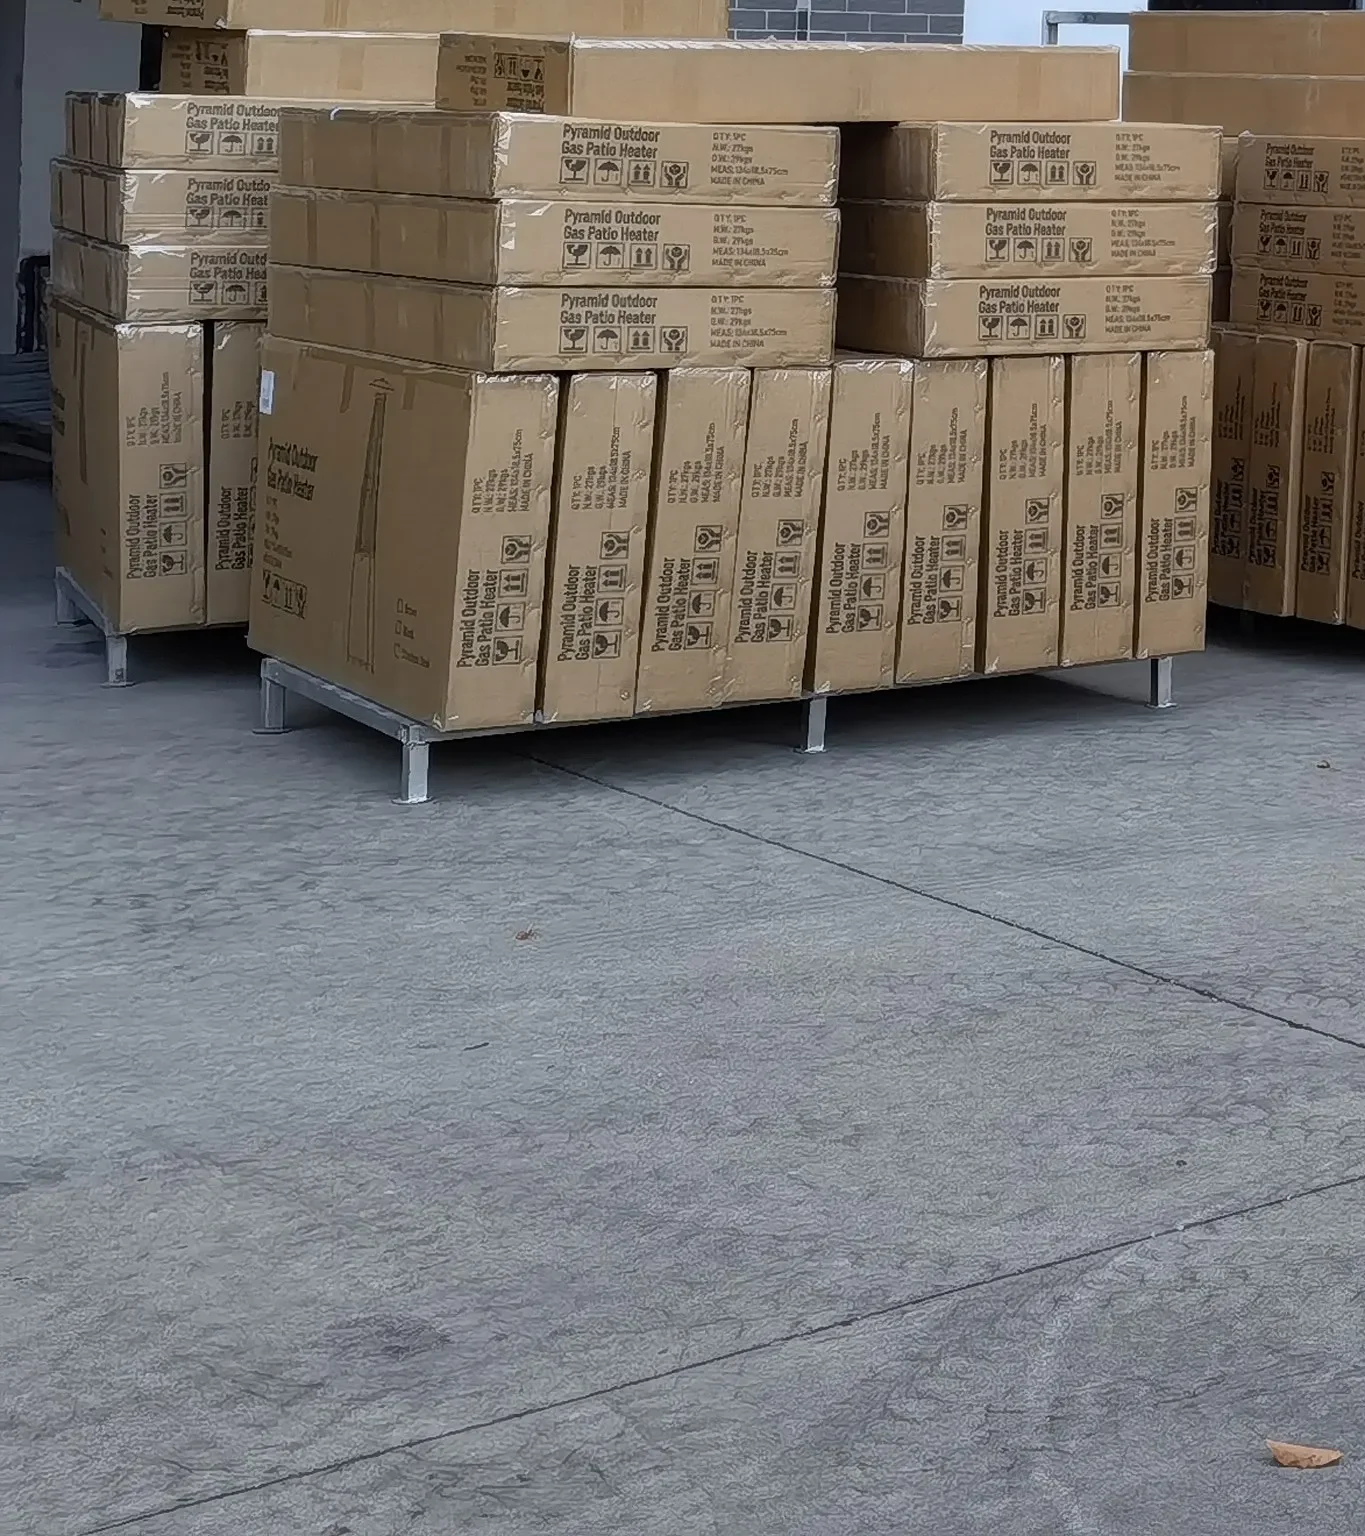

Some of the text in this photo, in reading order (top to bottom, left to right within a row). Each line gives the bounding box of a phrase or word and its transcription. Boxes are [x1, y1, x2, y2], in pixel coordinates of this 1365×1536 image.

[187, 102, 233, 117] Pyramid
[186, 117, 207, 129] Gas
[210, 117, 239, 130] Patio
[563, 124, 660, 143] Pyramid Outdoor
[990, 130, 1071, 146] Pyramid Outdoor
[562, 142, 658, 158] Gas Patio Heater
[990, 146, 1070, 159] Gas Patio Heater
[187, 178, 234, 191] Pyramid
[186, 193, 207, 204] Gas
[210, 194, 239, 205] Patio
[564, 208, 660, 226] Pyramid Outdoor
[986, 208, 1066, 222] Pyramid Outdoor
[564, 226, 659, 242] Gas Patio Heater
[986, 222, 1066, 236] Gas Patio Heater
[191, 251, 237, 267] Pyramid
[190, 268, 211, 279] Gas
[214, 268, 242, 280] Patio
[980, 285, 1060, 299] Pyramid Outdoor
[561, 293, 658, 310] Pyramid Outdoor
[978, 300, 1059, 313] Gas Patio Heater
[560, 310, 656, 324] Gas Patio Heater
[1145, 519, 1160, 603] Pyramid Outdoor
[1160, 518, 1173, 601] Gas Patio Heater
[457, 569, 480, 667] Pyramid Outdoor
[475, 569, 498, 667] Gas Patio Heater
